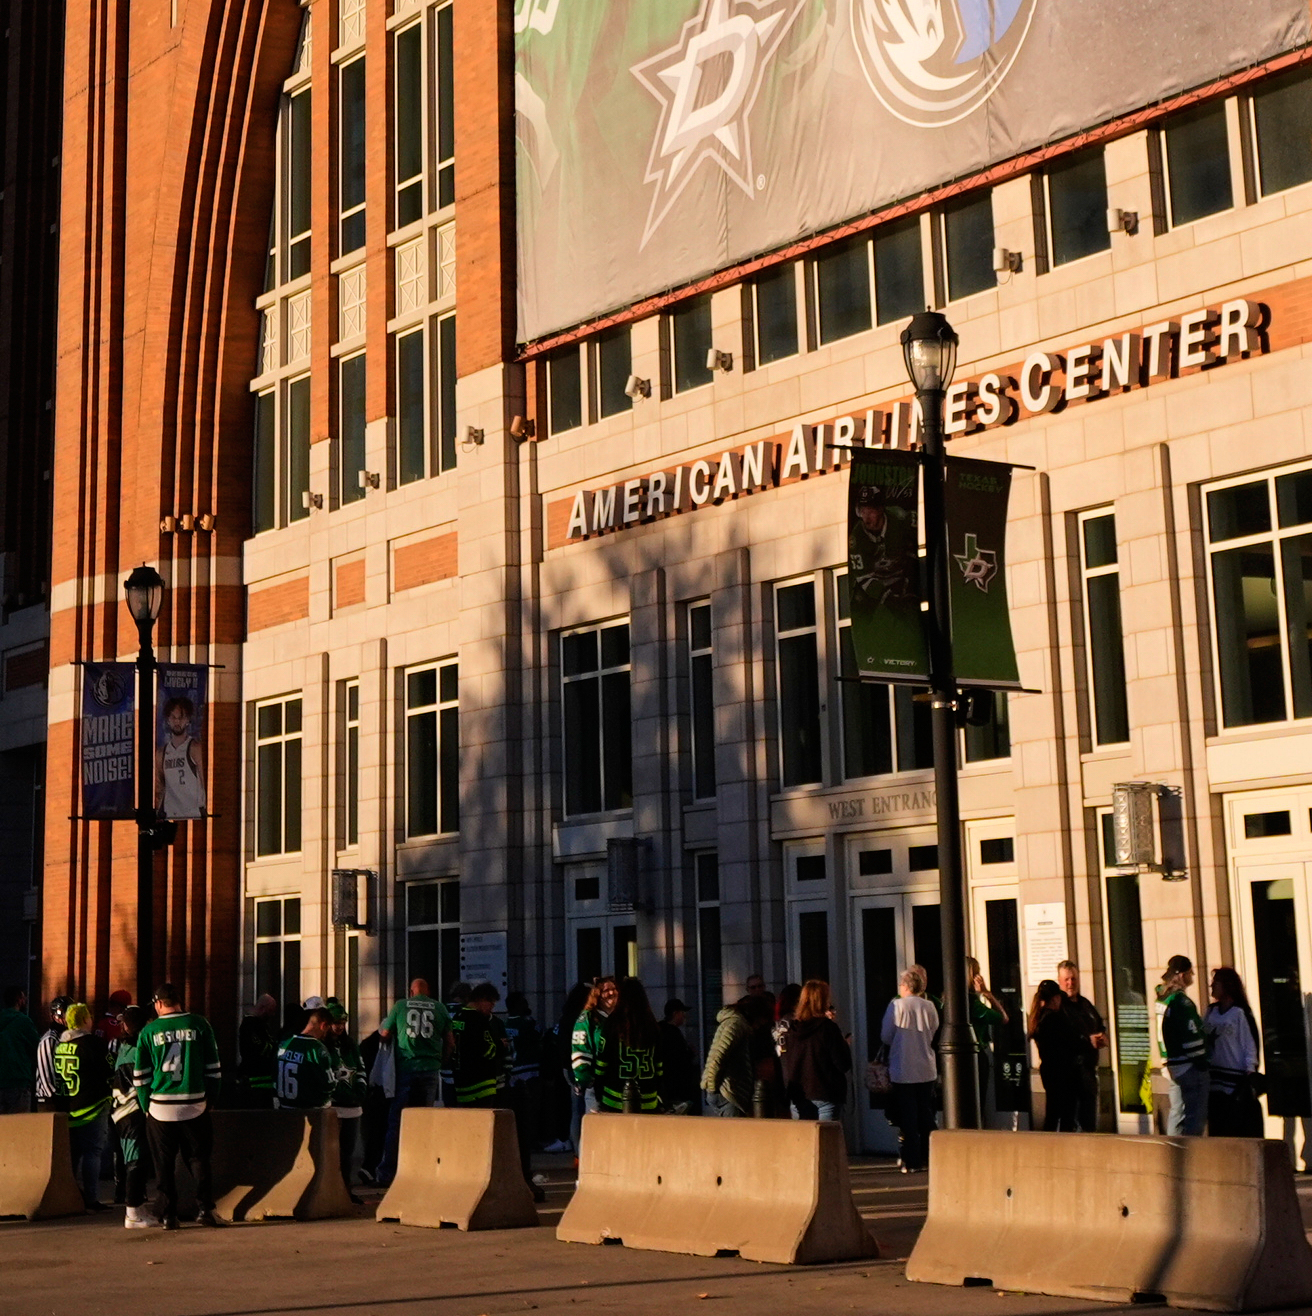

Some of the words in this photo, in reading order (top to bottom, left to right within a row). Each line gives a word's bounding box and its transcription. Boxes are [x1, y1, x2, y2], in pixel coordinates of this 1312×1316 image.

[566, 439, 774, 539] AMERICAN
[781, 373, 1009, 479] AIRLINES
[1020, 298, 1260, 414] CENTER
[957, 482, 1004, 494] HOCKEY
[959, 472, 998, 485] TEXAS
[83, 711, 133, 746] MAKE
[83, 741, 133, 759] SOME
[83, 755, 132, 786] NOISE!
[178, 770, 186, 785] 2
[828, 798, 866, 820] WEST
[872, 789, 937, 815] ENTRAN
[406, 1009, 435, 1039] 96
[161, 1042, 183, 1082] 4
[618, 1039, 656, 1080] 53
[277, 1060, 299, 1100] 16
